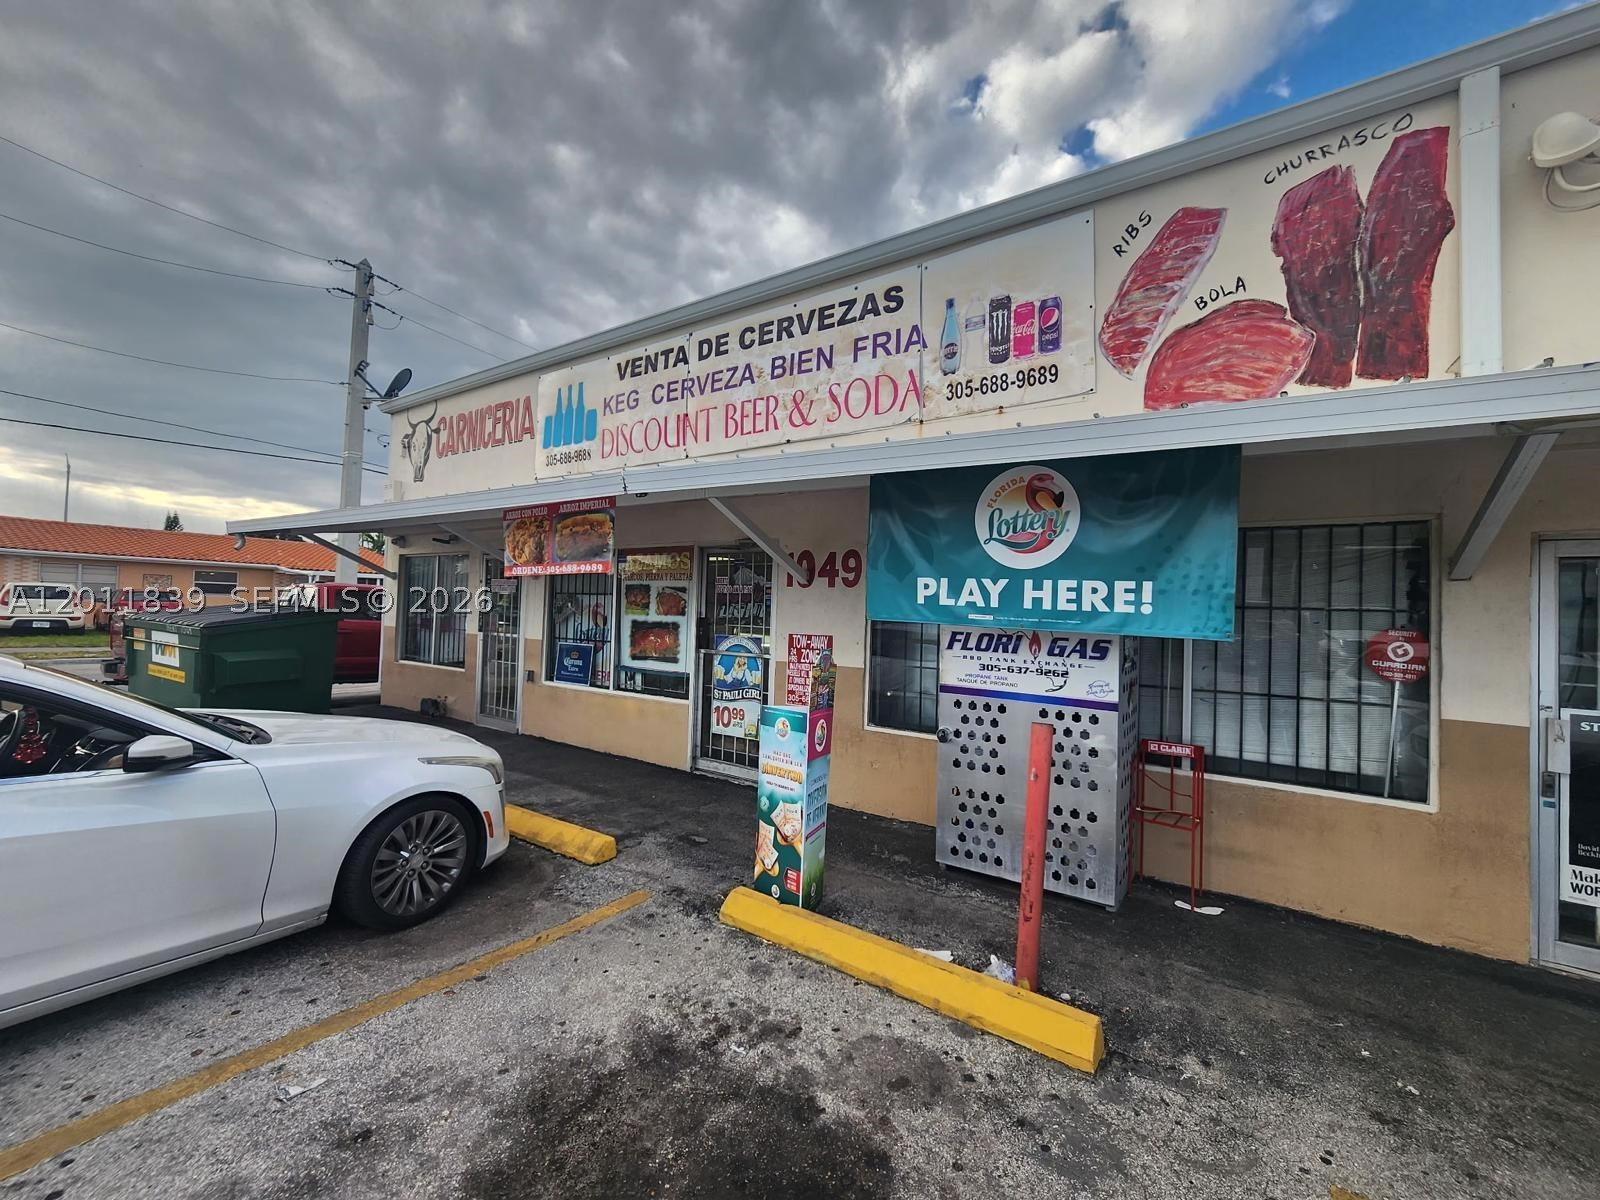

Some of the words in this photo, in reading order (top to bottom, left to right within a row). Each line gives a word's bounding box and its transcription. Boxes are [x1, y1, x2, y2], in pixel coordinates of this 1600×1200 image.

[1264, 113, 1413, 185] CHURRASCO
[1113, 210, 1151, 258] RIBS
[1194, 276, 1246, 311] BOLA
[616, 344, 689, 382] VENTA
[697, 332, 730, 362] DE
[738, 284, 904, 349] CERVEZAS
[603, 389, 640, 417] KEG
[651, 362, 756, 406] CERVEZA
[770, 344, 834, 381] BIEN
[852, 323, 928, 363] FRIA
[945, 363, 1060, 402] 305-688-9689
[435, 395, 535, 459] CARNICERIA
[601, 405, 717, 459] DISCOUNT
[724, 394, 780, 439] BEER
[788, 389, 817, 429] &
[826, 368, 926, 424] SODA
[986, 475, 1026, 509] FLORIDA
[983, 507, 1072, 545] Lottery
[916, 577, 1009, 608] PLAY
[1023, 578, 1153, 615] HERE!
[792, 634, 829, 650] TOW-AWAY
[946, 630, 1023, 655] FLORI
[1046, 636, 1113, 662] GAS
[978, 663, 1070, 679] 305-637-9262
[989, 656, 1016, 664] TANK
[1372, 660, 1426, 671] GUARDIAN
[722, 690, 743, 700] PAULI
[742, 689, 761, 700] GIRL
[956, 677, 977, 686] TANQUE
[965, 673, 991, 681] PROPANE
[993, 674, 1008, 682] TANK
[1160, 745, 1192, 755] CLARIN
